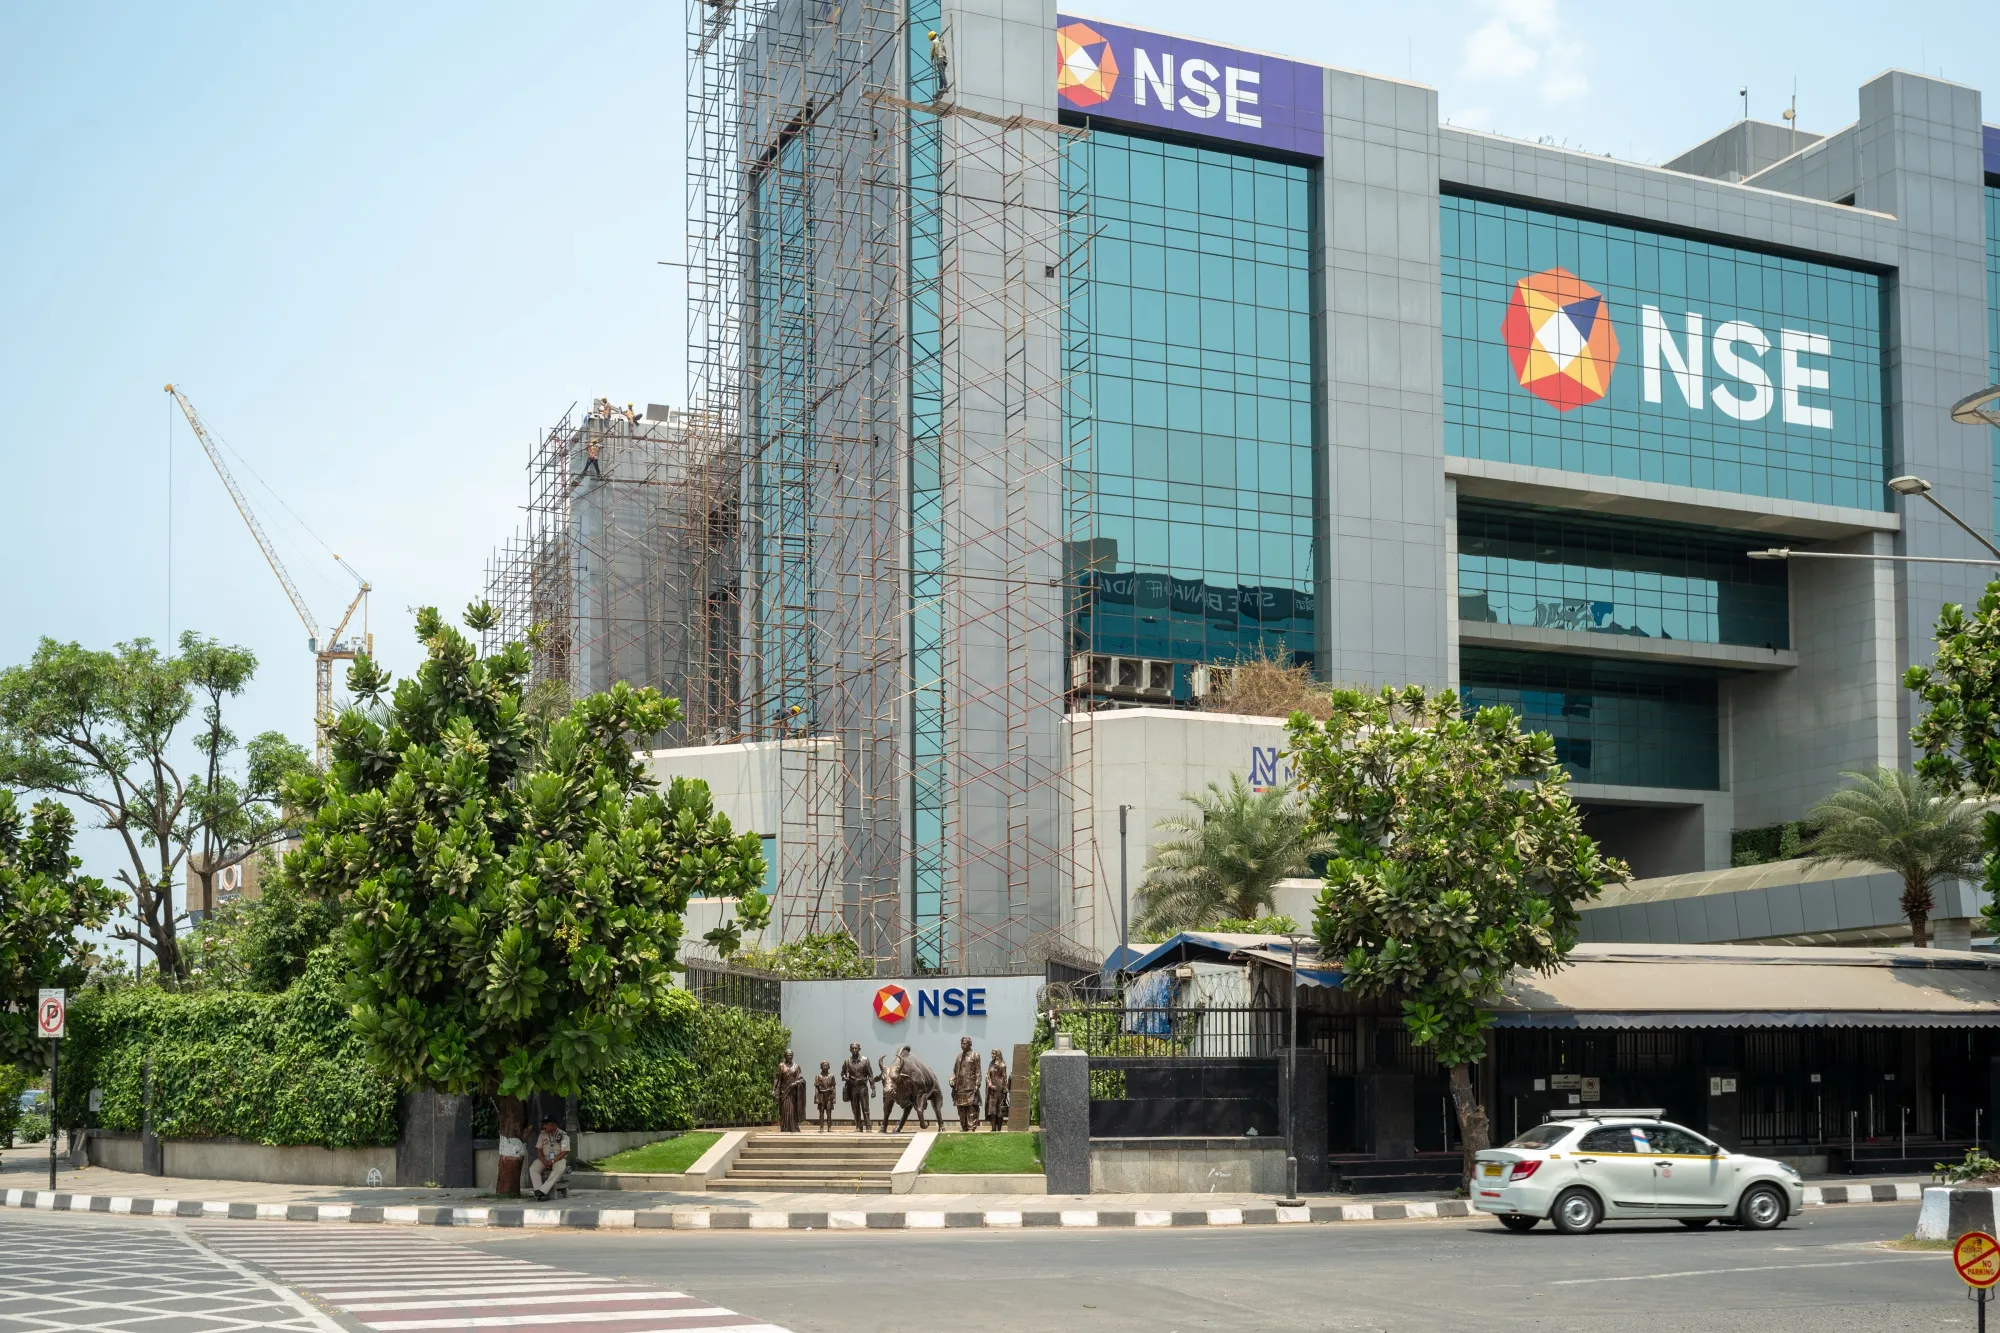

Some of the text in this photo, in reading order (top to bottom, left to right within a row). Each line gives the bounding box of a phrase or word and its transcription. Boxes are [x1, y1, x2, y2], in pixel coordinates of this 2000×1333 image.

[1134, 48, 1262, 128] NSE
[1642, 304, 1833, 429] NSE
[217, 864, 242, 891] 101
[918, 988, 987, 1017] NSE
[1982, 1260, 1992, 1268] NO
